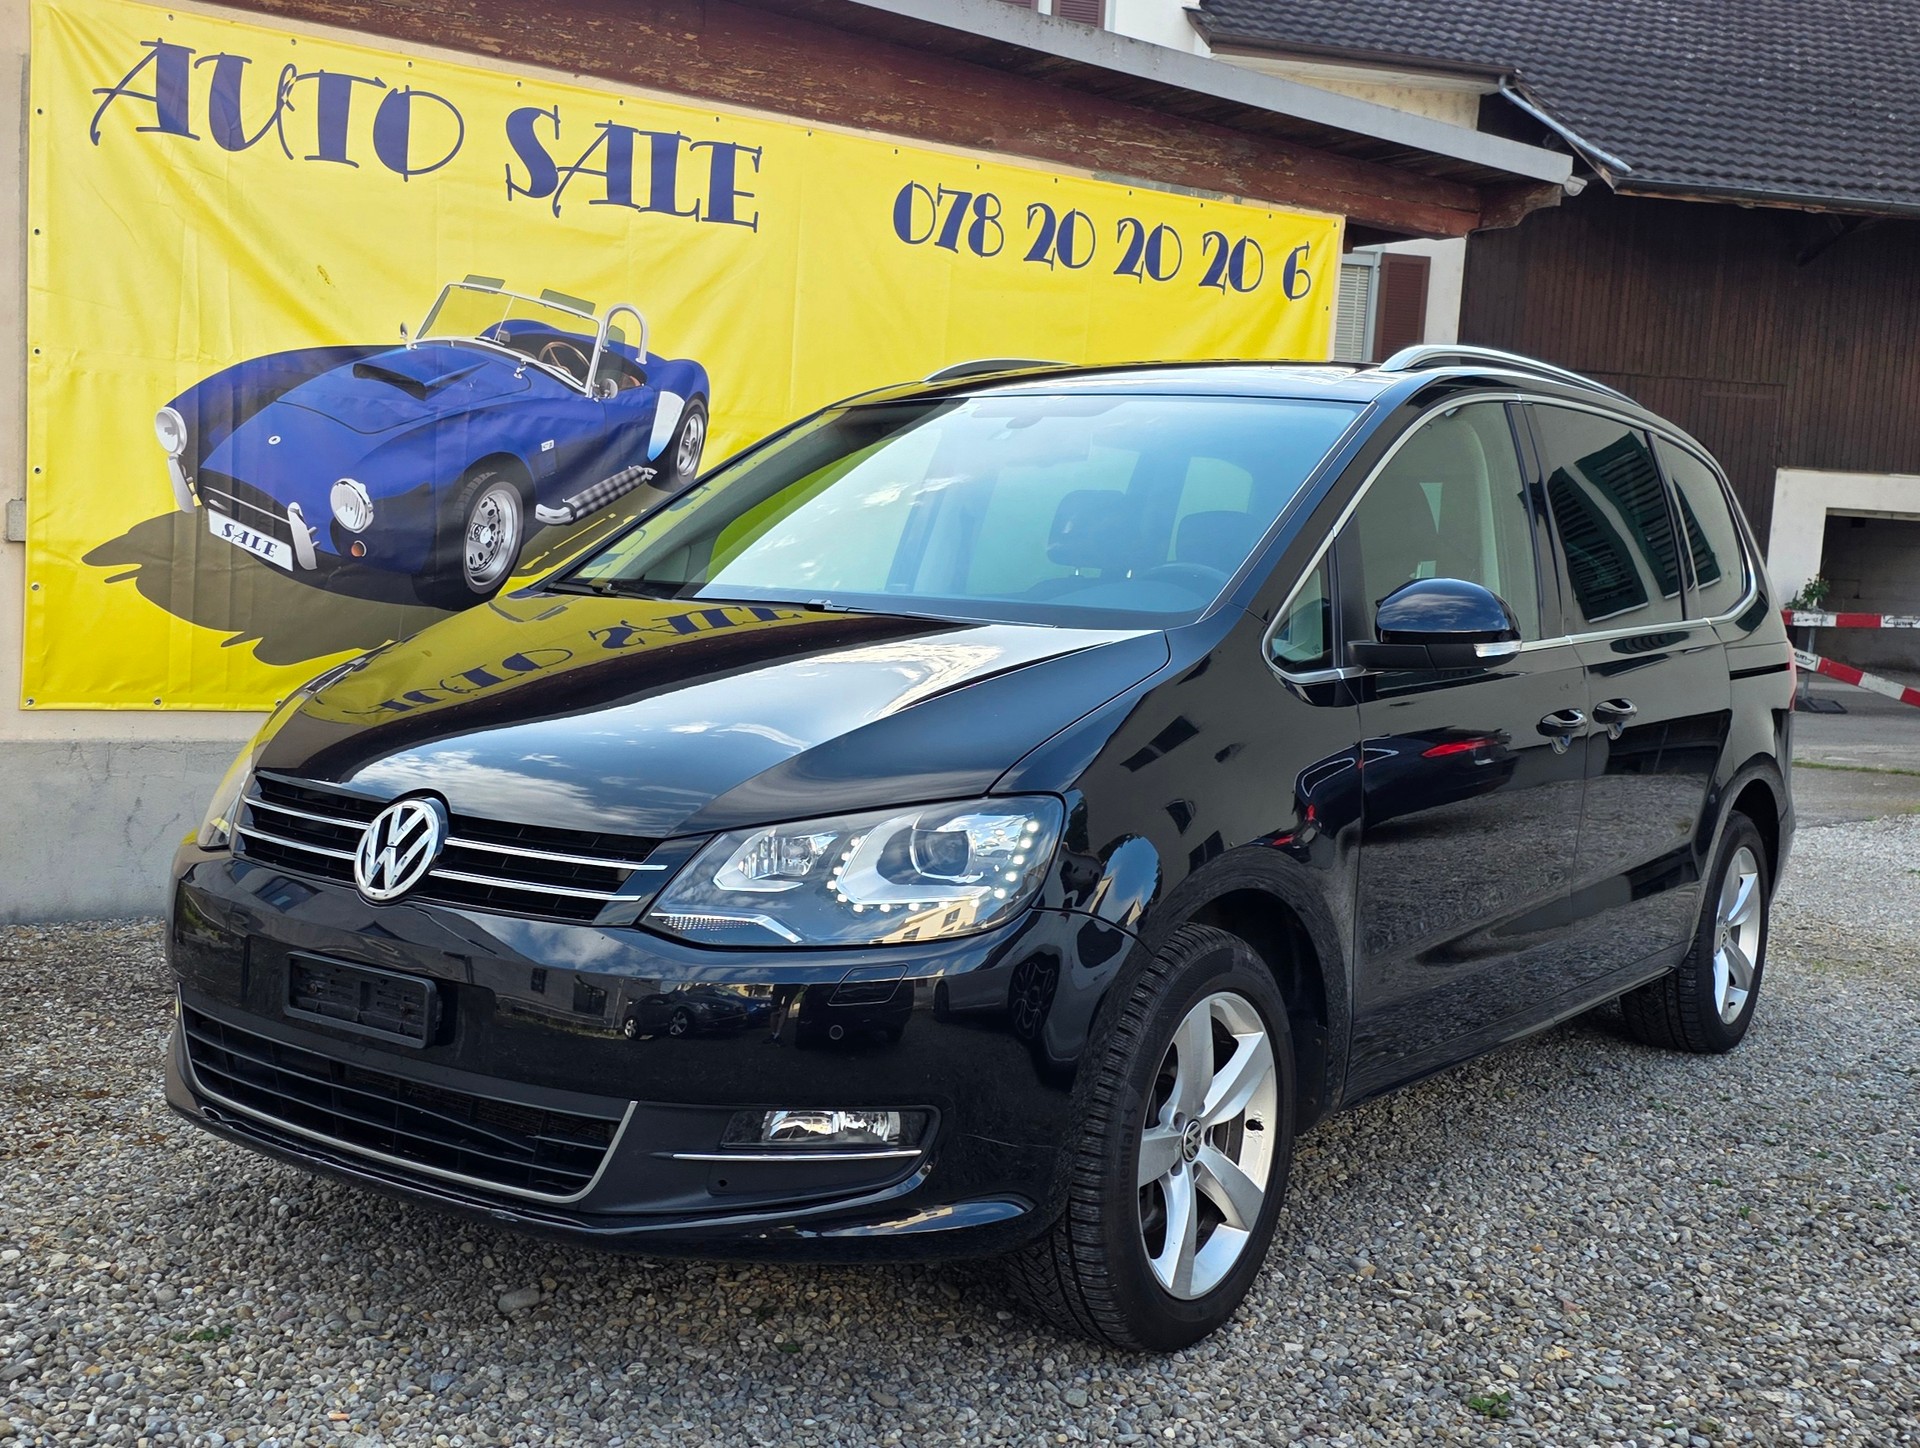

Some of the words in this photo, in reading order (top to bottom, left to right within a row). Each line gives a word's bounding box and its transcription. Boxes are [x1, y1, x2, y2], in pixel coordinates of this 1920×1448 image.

[90, 37, 465, 182] AUTO
[505, 105, 763, 233] SALE
[893, 179, 1005, 258] 078
[1023, 202, 1096, 271] 20
[1113, 217, 1182, 284] 20
[1198, 230, 1264, 295] 20
[1282, 241, 1311, 301] 6
[221, 523, 278, 558] SALE
[354, 799, 440, 900] VW
